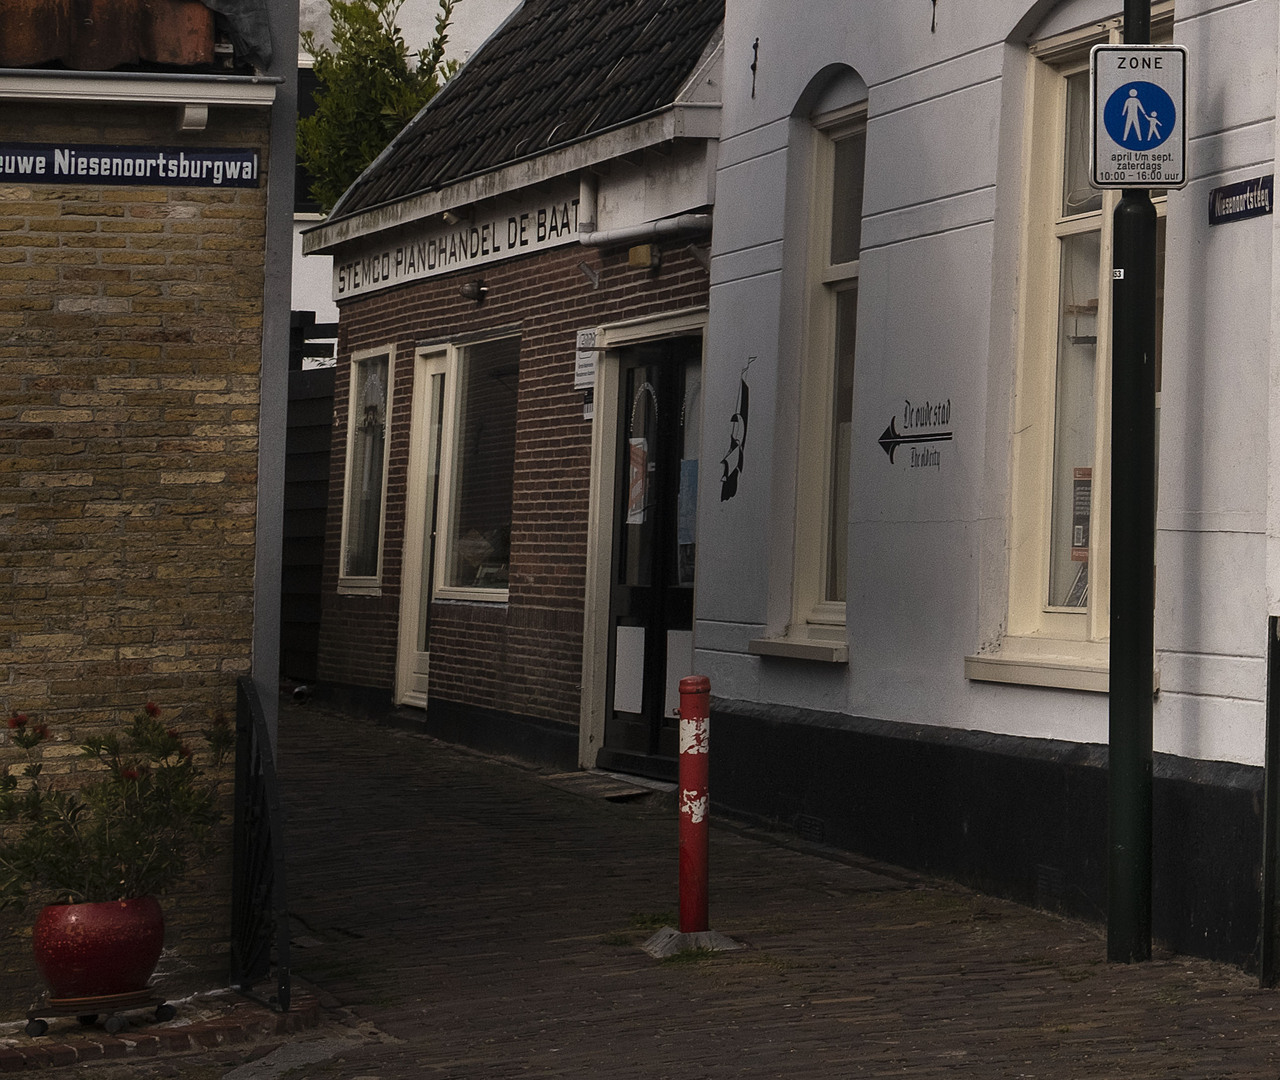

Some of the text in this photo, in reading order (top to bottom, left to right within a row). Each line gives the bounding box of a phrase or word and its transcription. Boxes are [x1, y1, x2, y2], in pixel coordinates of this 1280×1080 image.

[1117, 57, 1163, 69] ZONE
[1111, 152, 1174, 162] april t/m sept.
[53, 148, 258, 185] Niesenoortsburgwal
[1116, 161, 1162, 172] zaterdags
[1100, 171, 1126, 181] 10:00
[1137, 171, 1162, 181] 16:00
[1164, 173, 1180, 181] uur
[338, 199, 580, 294] STEMCO PIANOHANDEL DE BAAT
